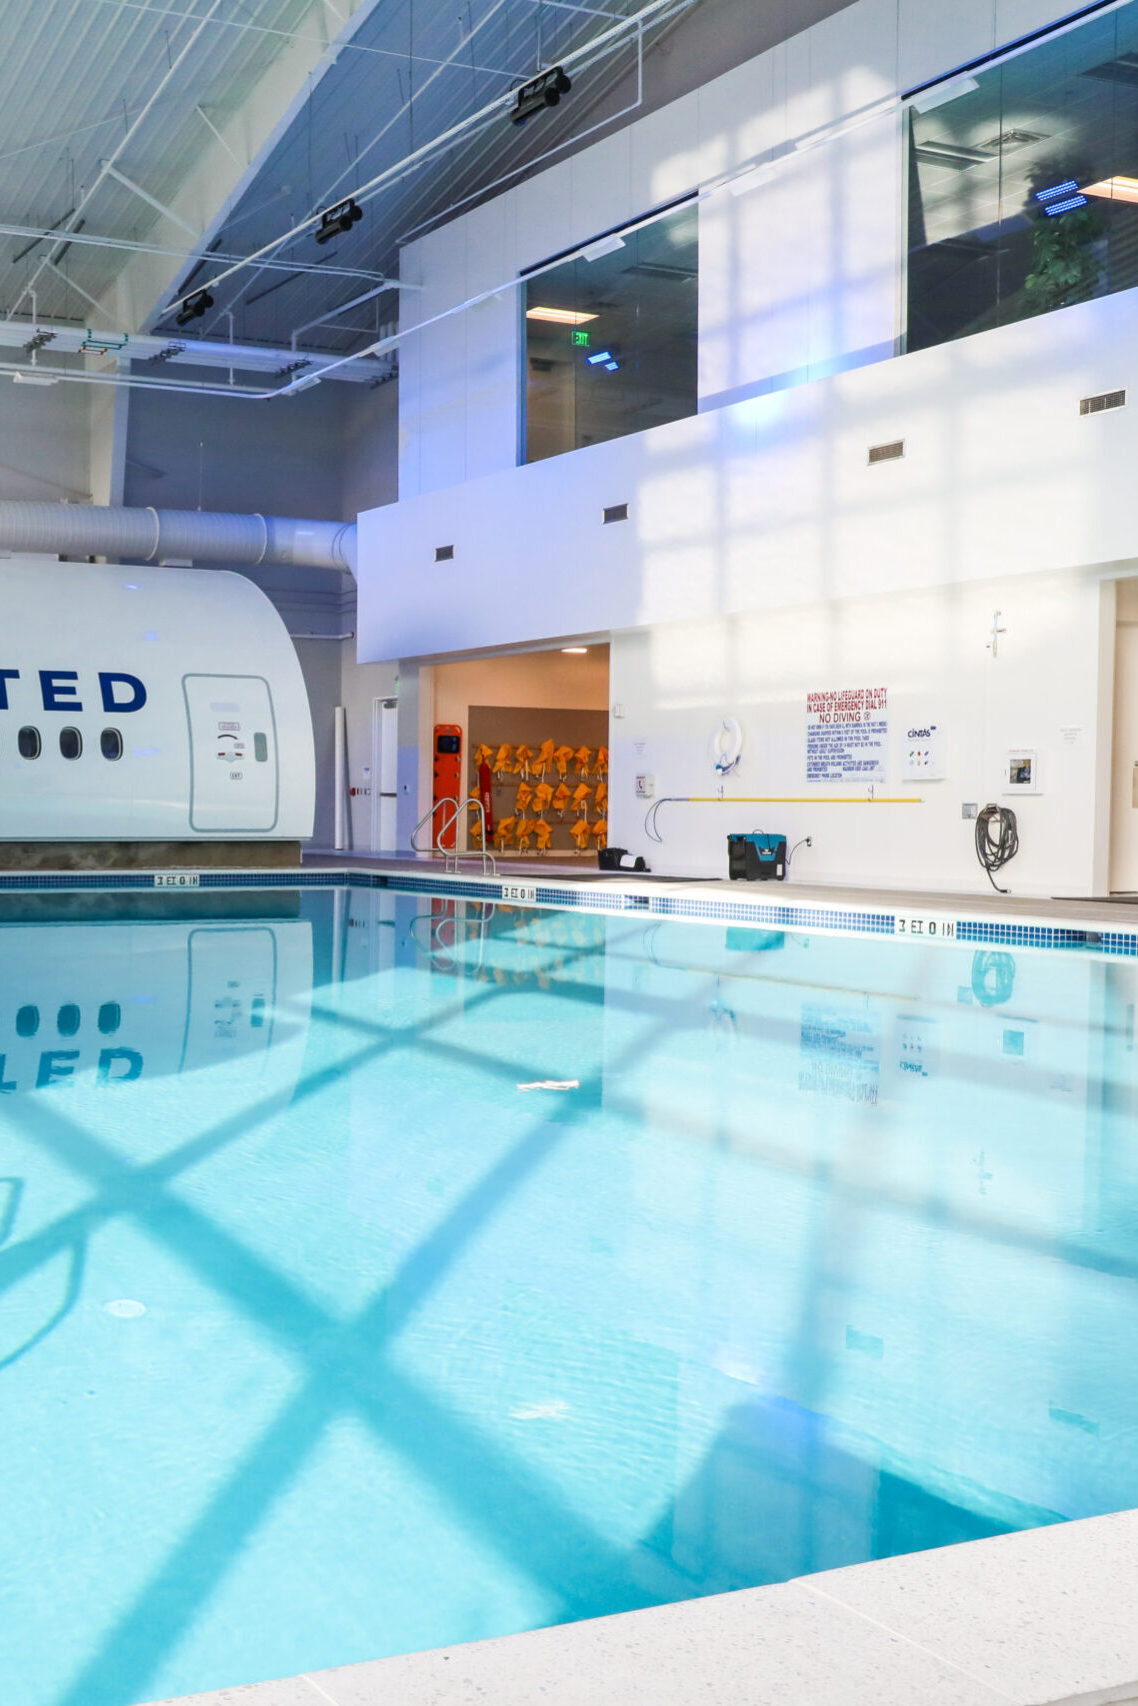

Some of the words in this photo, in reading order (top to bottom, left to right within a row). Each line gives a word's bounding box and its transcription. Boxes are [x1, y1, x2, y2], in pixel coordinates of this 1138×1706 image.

[838, 688, 864, 700] LIFEGUARD
[866, 688, 873, 699] ON
[874, 688, 887, 698] DUTY
[807, 703, 812, 712] IN
[813, 702, 826, 712] CASE
[827, 701, 834, 712] OF
[834, 700, 864, 712] EMERGENCY
[866, 699, 877, 710] DIAL
[878, 698, 887, 709] 911
[819, 712, 831, 723] NO
[834, 712, 860, 723] DIVING
